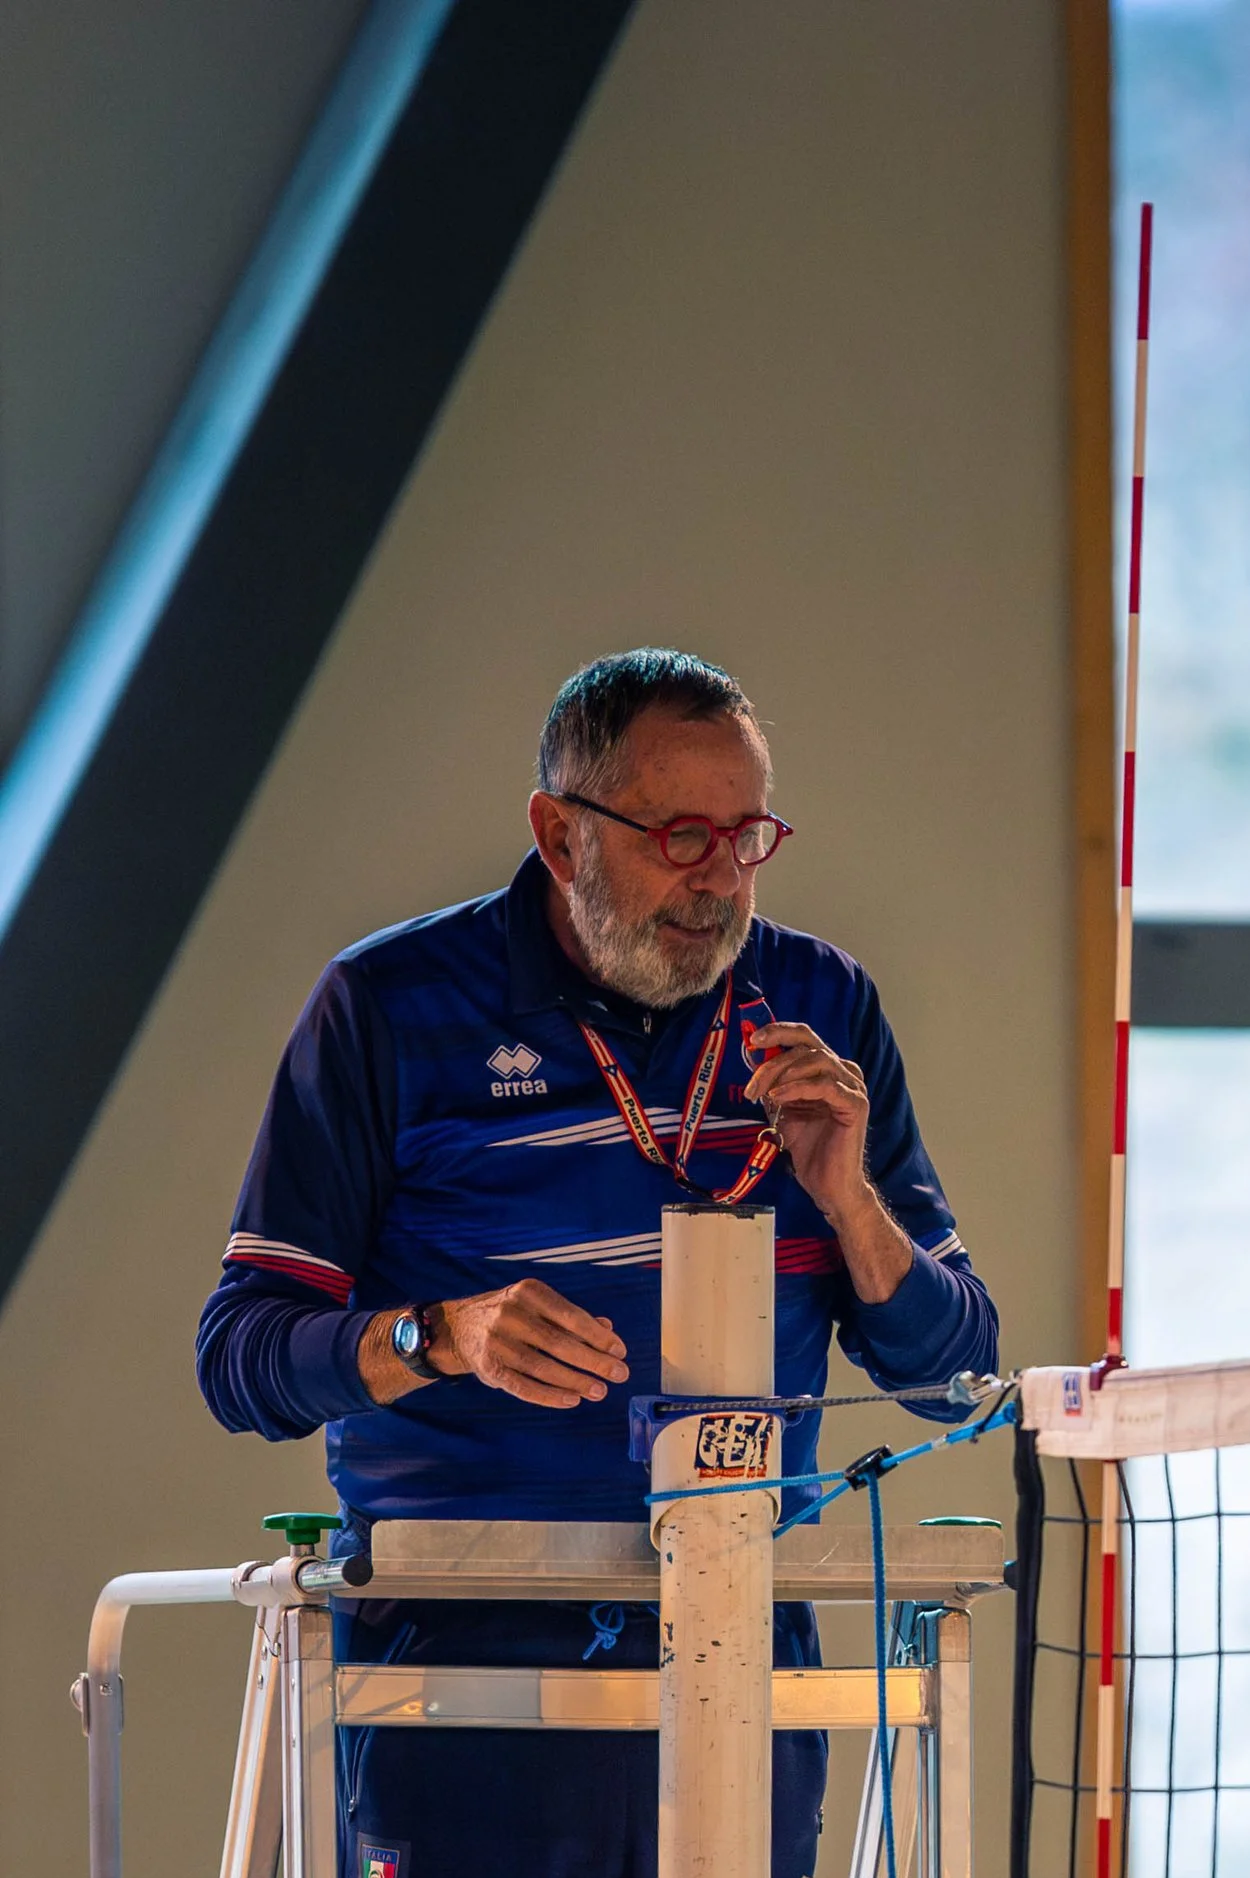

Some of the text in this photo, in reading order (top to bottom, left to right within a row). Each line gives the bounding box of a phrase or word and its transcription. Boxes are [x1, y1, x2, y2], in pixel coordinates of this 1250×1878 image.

[490, 1079, 548, 1097] errea
[684, 1054, 715, 1133] Puerto Rico
[623, 1098, 649, 1145] Puerto
[363, 1848, 392, 1861] ITALIA
